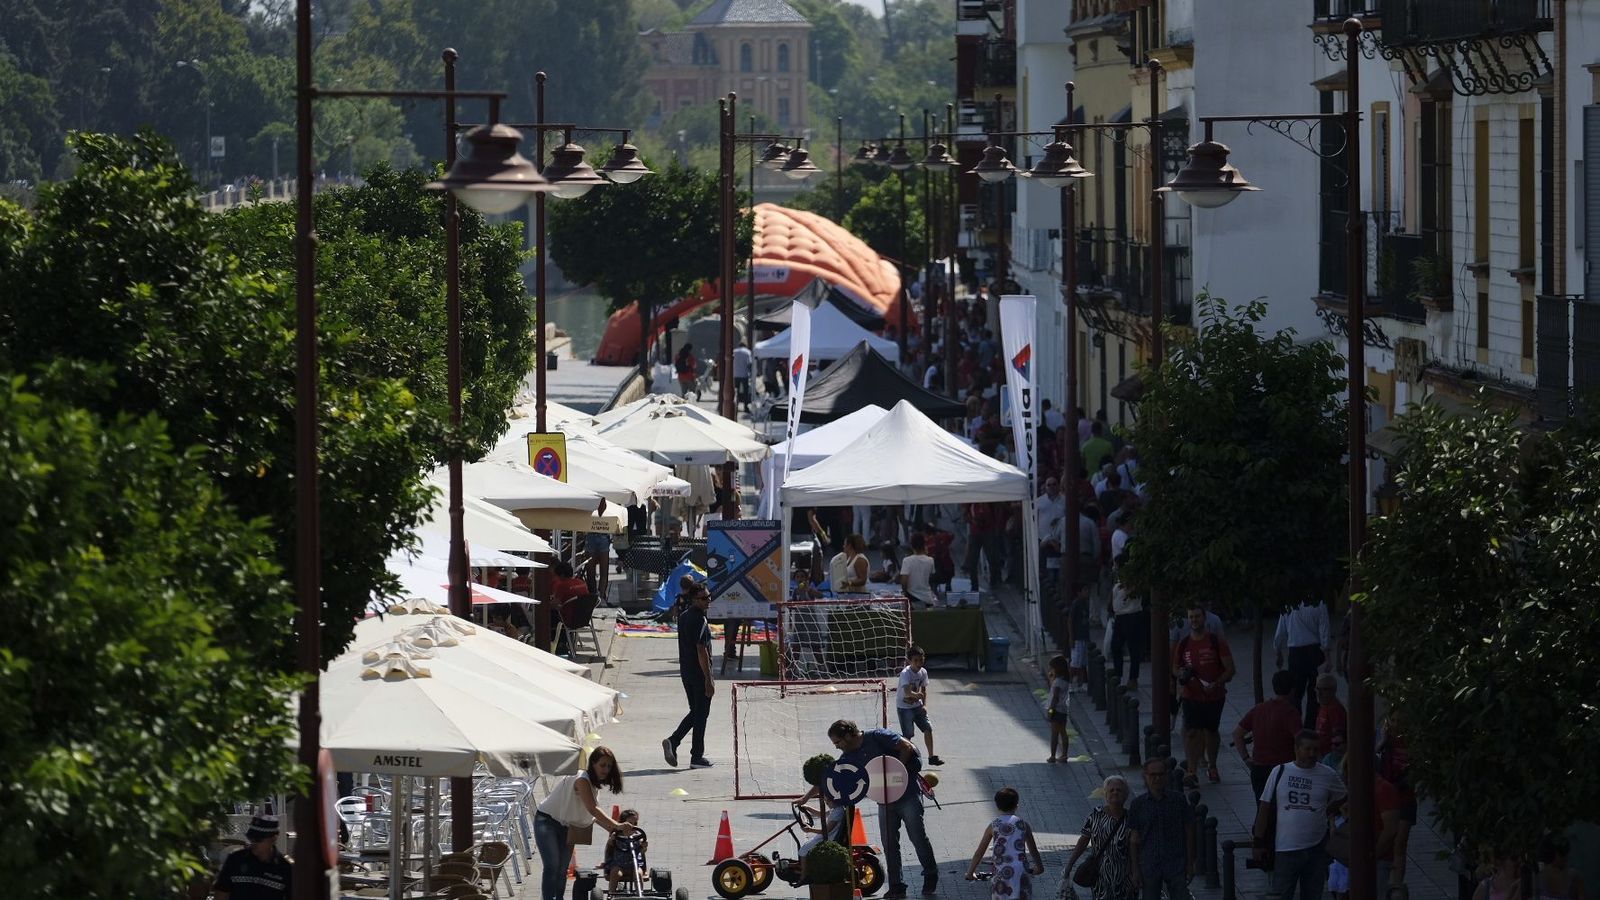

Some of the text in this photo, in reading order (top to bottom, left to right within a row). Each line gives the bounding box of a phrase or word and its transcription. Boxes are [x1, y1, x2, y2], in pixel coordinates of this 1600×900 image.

[1021, 388, 1035, 514] elvetia
[373, 755, 423, 768] AMSTEL
[1289, 791, 1310, 804] 63
